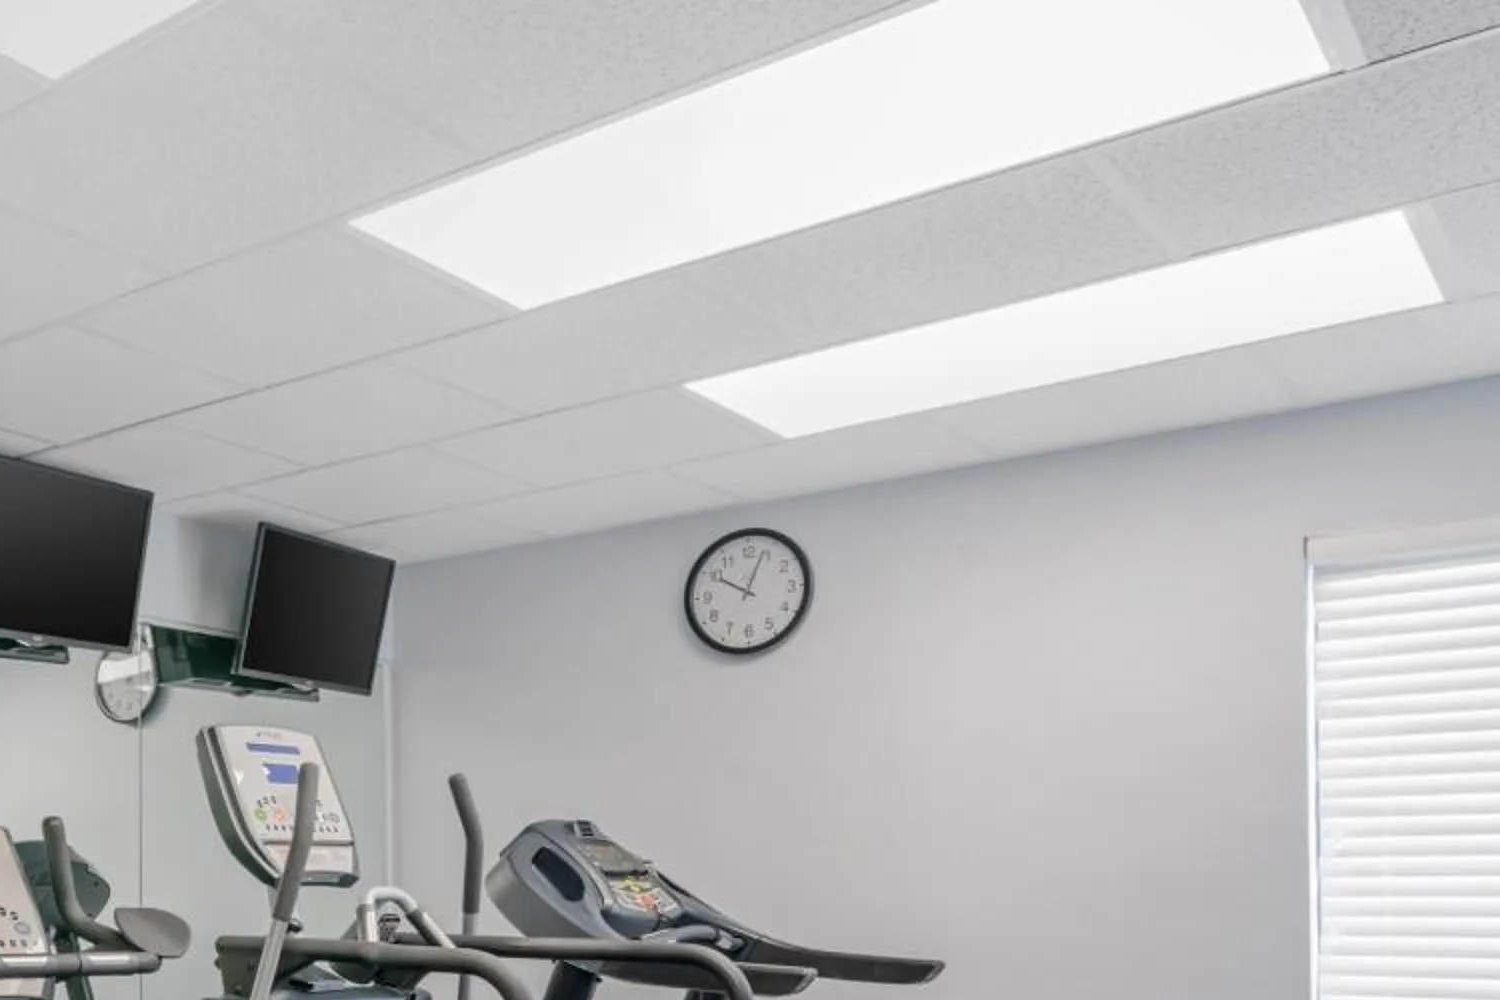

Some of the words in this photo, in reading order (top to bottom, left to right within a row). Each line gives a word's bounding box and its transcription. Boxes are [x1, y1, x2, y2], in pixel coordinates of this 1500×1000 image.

[722, 555, 734, 569] 11
[779, 559, 789, 573] 2
[787, 579, 797, 593] 3
[709, 609, 719, 622] 8
[726, 621, 734, 635] 7
[743, 623, 754, 638] 6
[764, 617, 775, 630] 5
